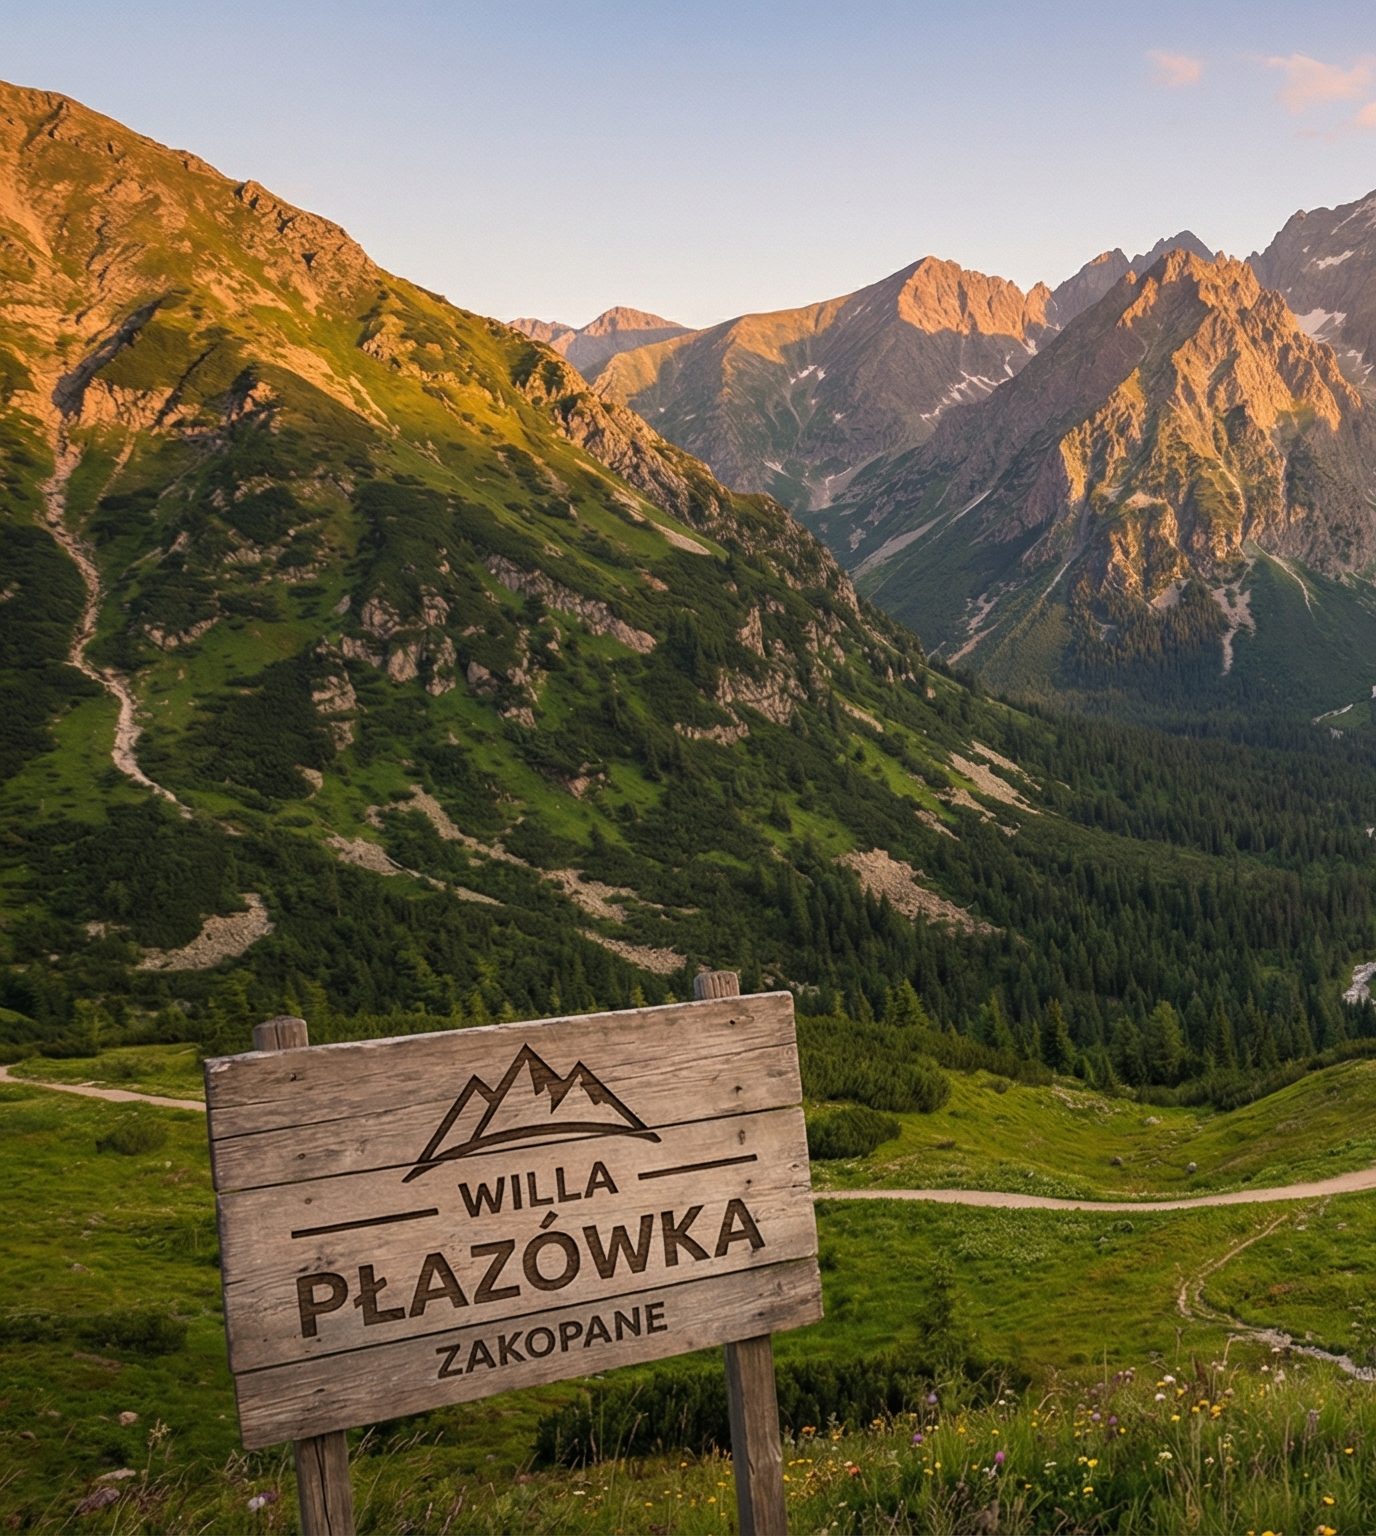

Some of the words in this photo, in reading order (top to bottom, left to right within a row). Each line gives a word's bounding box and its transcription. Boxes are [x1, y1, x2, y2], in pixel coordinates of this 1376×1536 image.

[458, 1161, 619, 1218] WILLA
[296, 1198, 766, 1338] PŁAZÓWKA
[435, 1302, 668, 1379] ZAKOPANE
